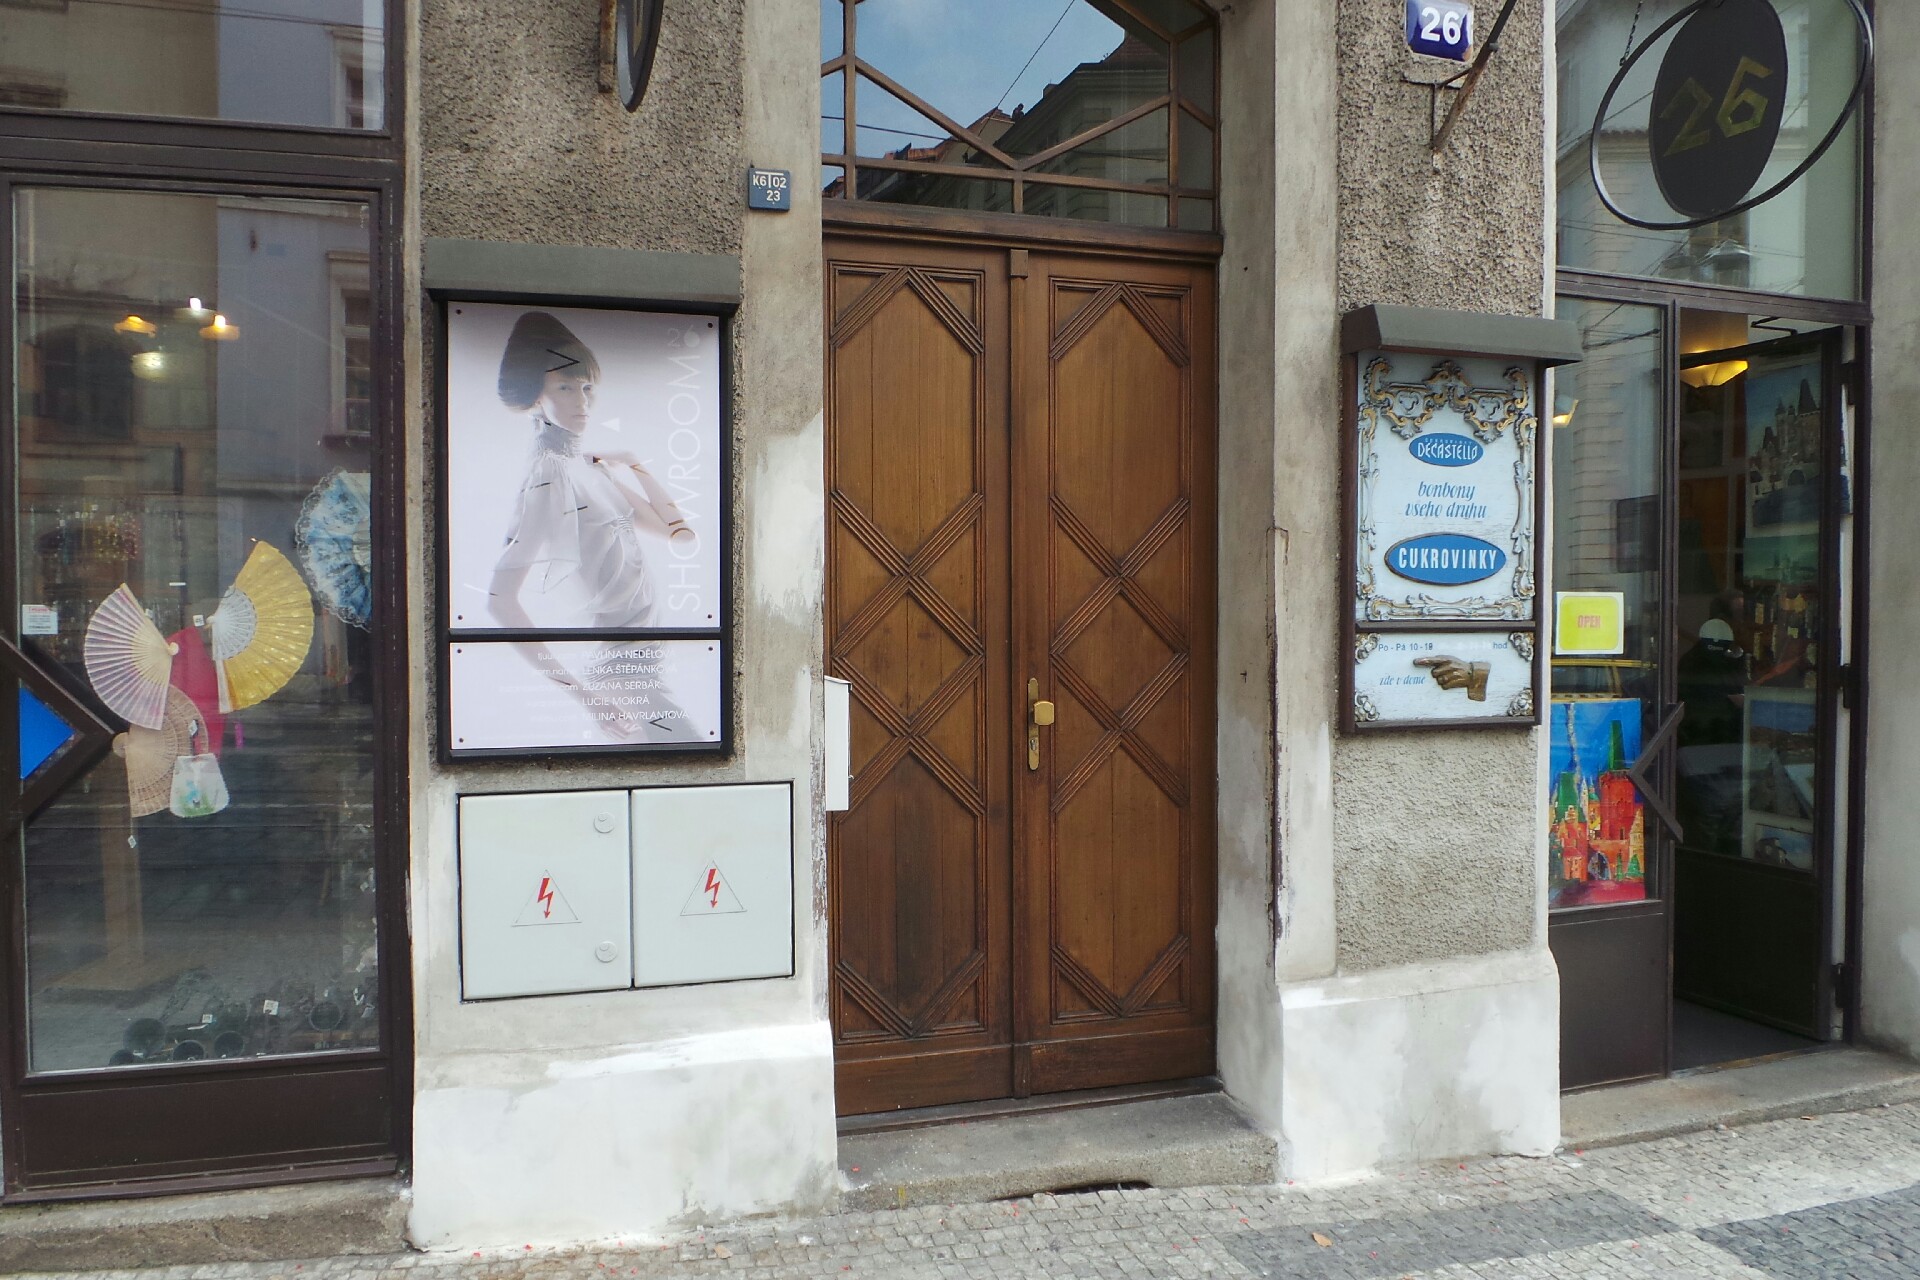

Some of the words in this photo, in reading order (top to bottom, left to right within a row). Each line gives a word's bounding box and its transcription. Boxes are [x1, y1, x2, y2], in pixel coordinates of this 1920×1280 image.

[1421, 6, 1461, 45] 26
[1659, 56, 1773, 157] 26
[766, 189, 781, 202] 23
[1417, 442, 1479, 460] DECASTELLO
[668, 355, 701, 612] SHOWROOM
[1418, 481, 1476, 502] bonbony
[1398, 547, 1498, 570] CUKROVINKY
[1577, 615, 1601, 628] OPEN
[1378, 643, 1389, 652] Po
[582, 697, 609, 706] LUCIE
